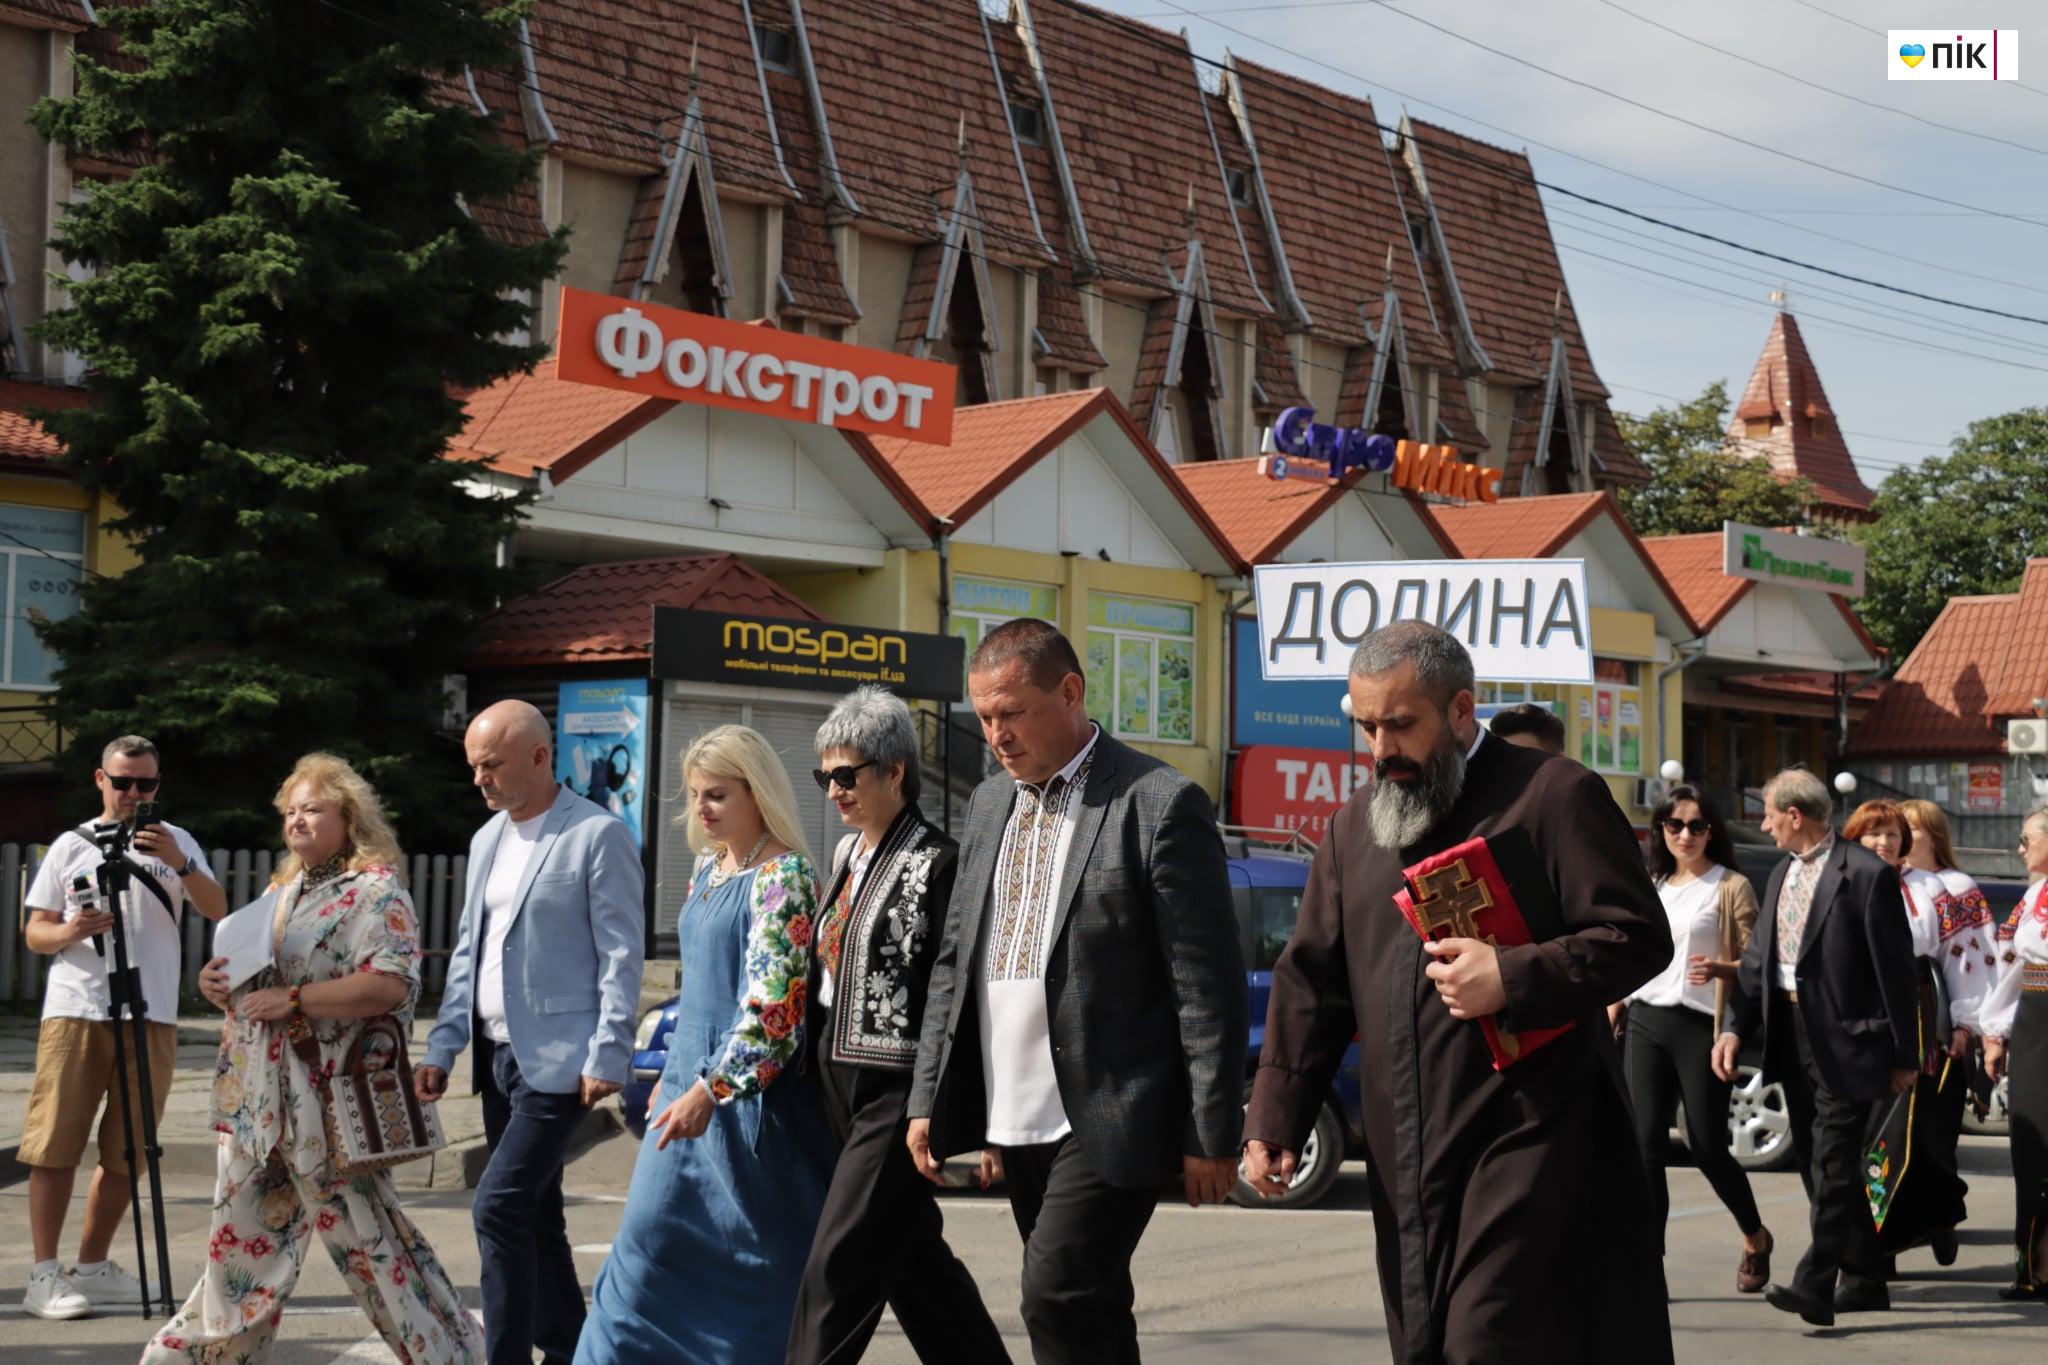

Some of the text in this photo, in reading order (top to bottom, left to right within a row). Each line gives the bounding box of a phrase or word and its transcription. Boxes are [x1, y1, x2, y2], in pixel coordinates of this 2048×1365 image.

[594, 306, 933, 428] Фокстрот
[1270, 578, 1585, 661] ДОЛИНА
[723, 620, 907, 664] mospan
[725, 659, 905, 682] мобільні телефони та аксесуари if.ua
[1254, 711, 1341, 727] ВСЕ БУДЕ УКРАЇНА
